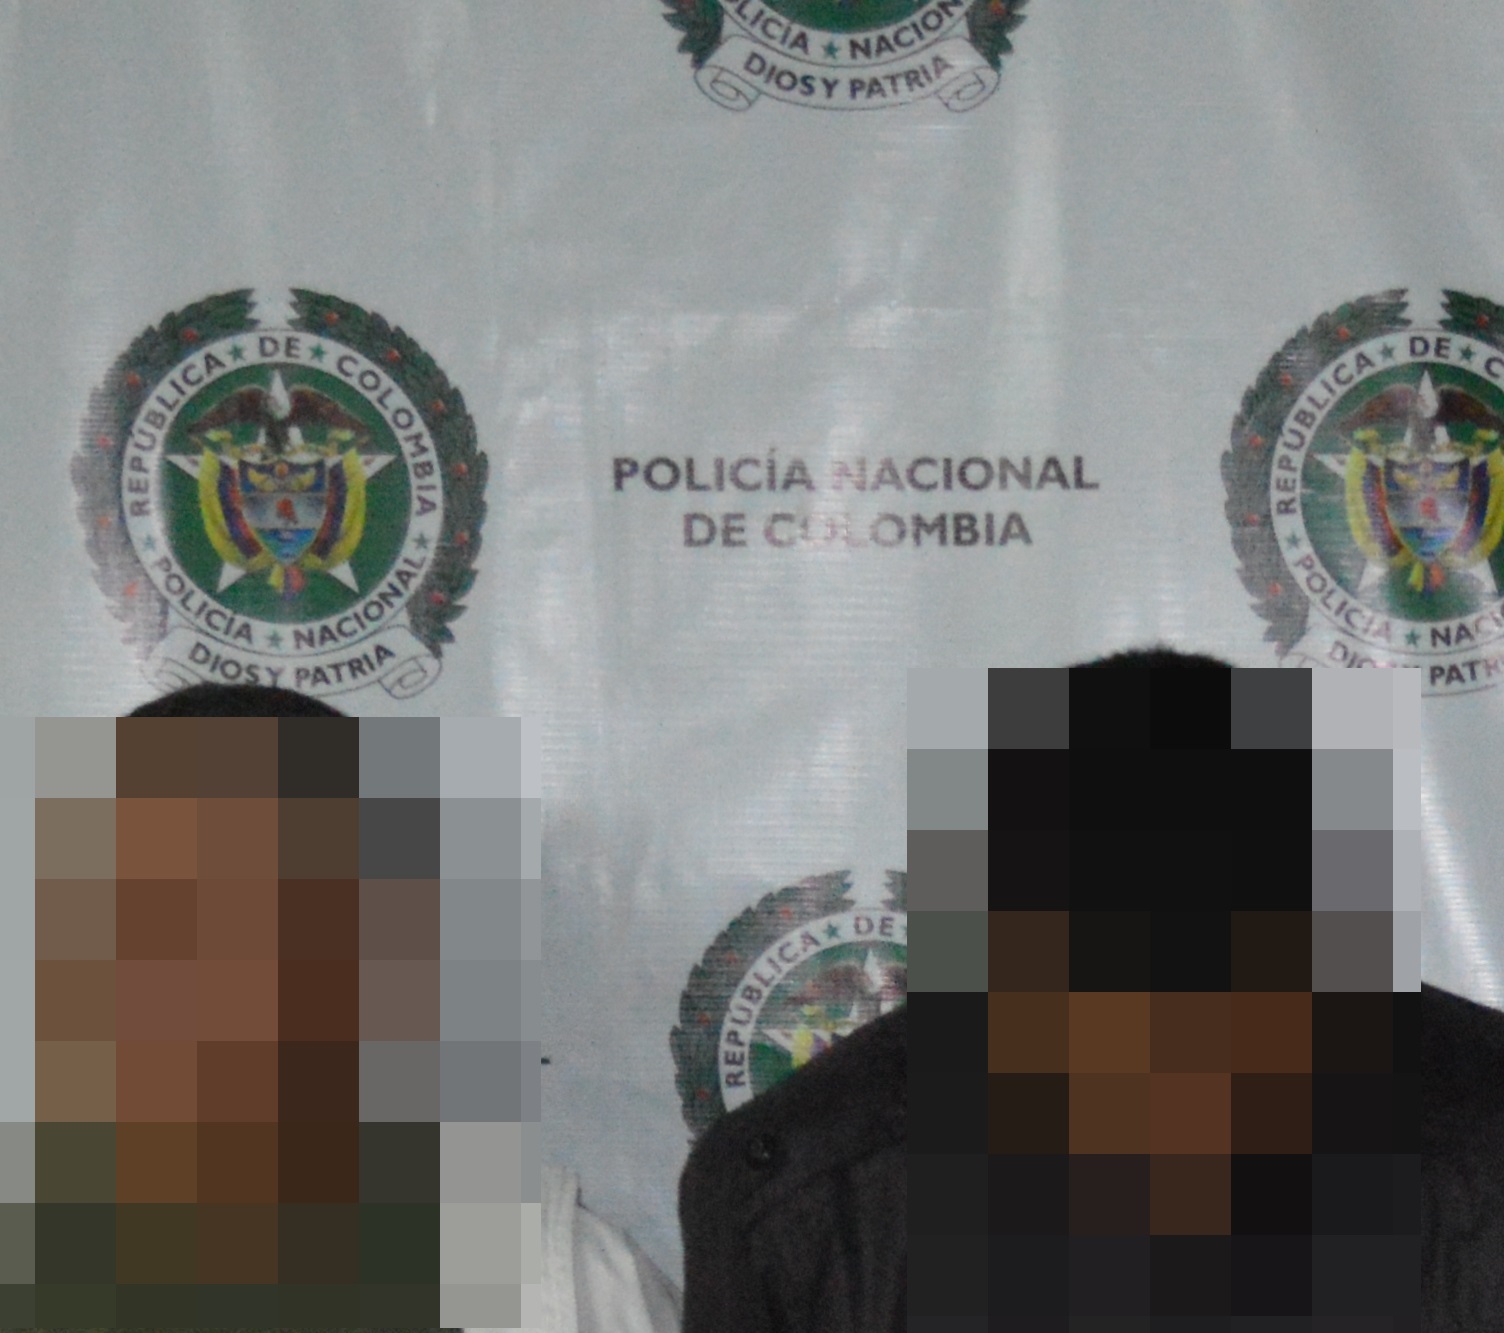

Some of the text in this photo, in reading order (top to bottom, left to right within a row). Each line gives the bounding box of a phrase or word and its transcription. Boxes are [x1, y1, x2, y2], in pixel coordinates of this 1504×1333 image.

[743, 52, 815, 97] DIOS
[849, 54, 955, 100] PATRIA
[1408, 335, 1451, 359] DE
[258, 336, 302, 359] DE
[336, 354, 438, 517] COLOMBIA
[612, 448, 1101, 494] POLICÍA NACIONAL
[682, 512, 1034, 551] DE COLOMBIA
[293, 554, 427, 650] NACIONAL
[295, 643, 396, 689] PATRIA
[853, 915, 895, 937] DE
